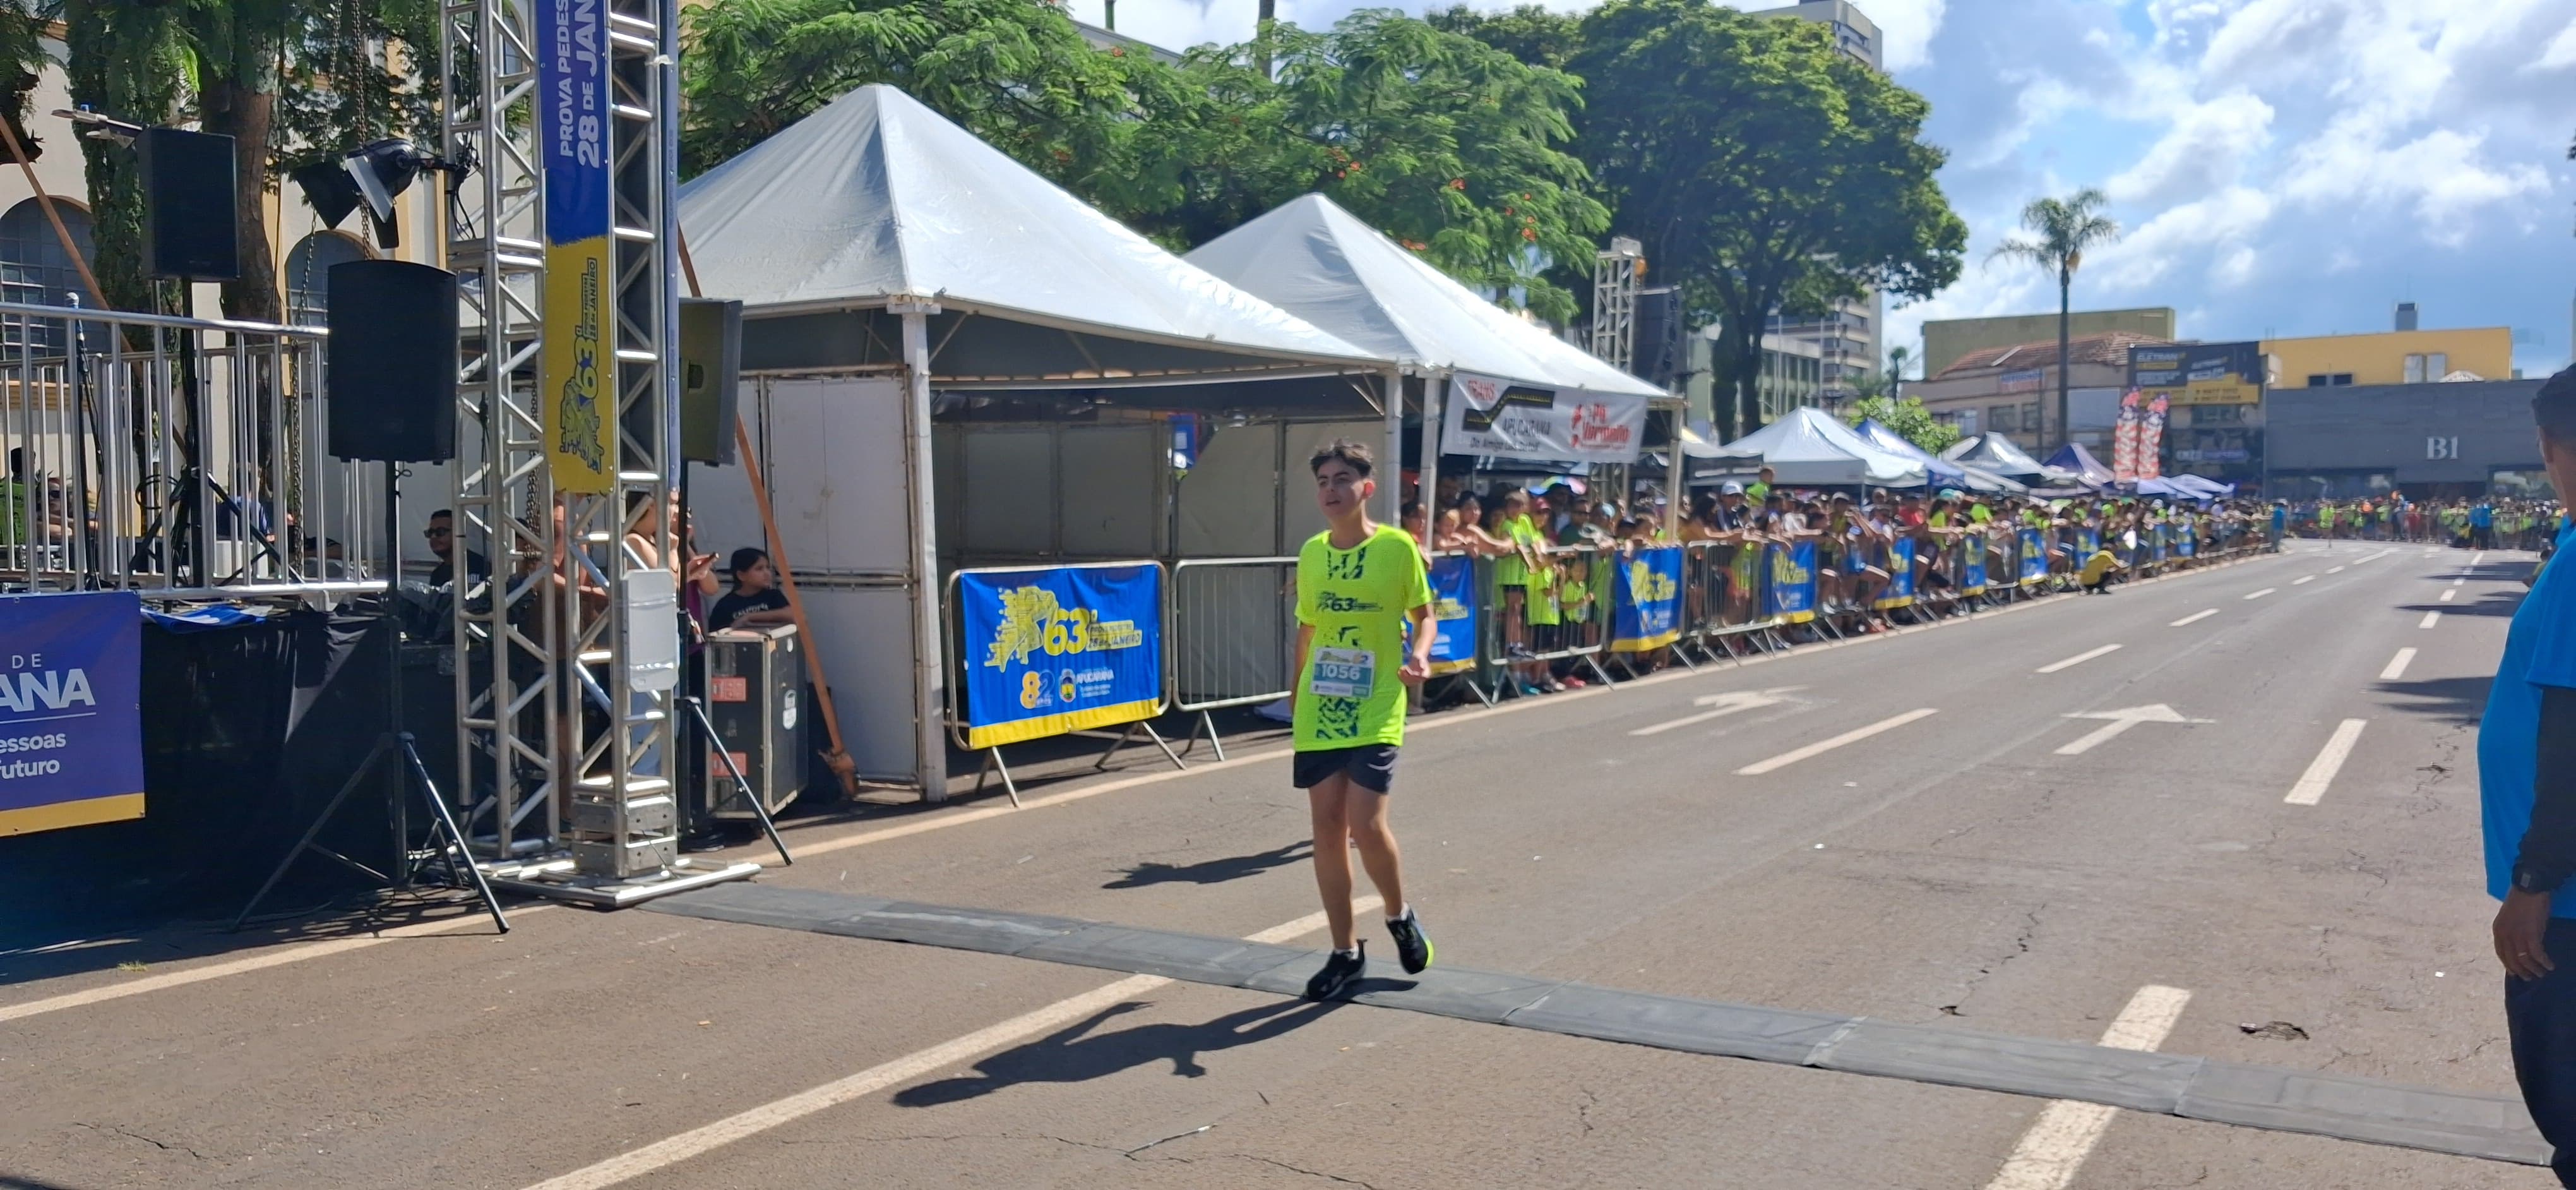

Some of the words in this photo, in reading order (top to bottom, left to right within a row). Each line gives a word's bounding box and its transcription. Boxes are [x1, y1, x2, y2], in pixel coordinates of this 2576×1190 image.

[581, 81, 595, 111] DE
[557, 77, 574, 157] PROVA
[576, 114, 600, 169] 28
[589, 325, 596, 338] 28
[11, 653, 42, 670] DE
[1321, 664, 1361, 680] 1056
